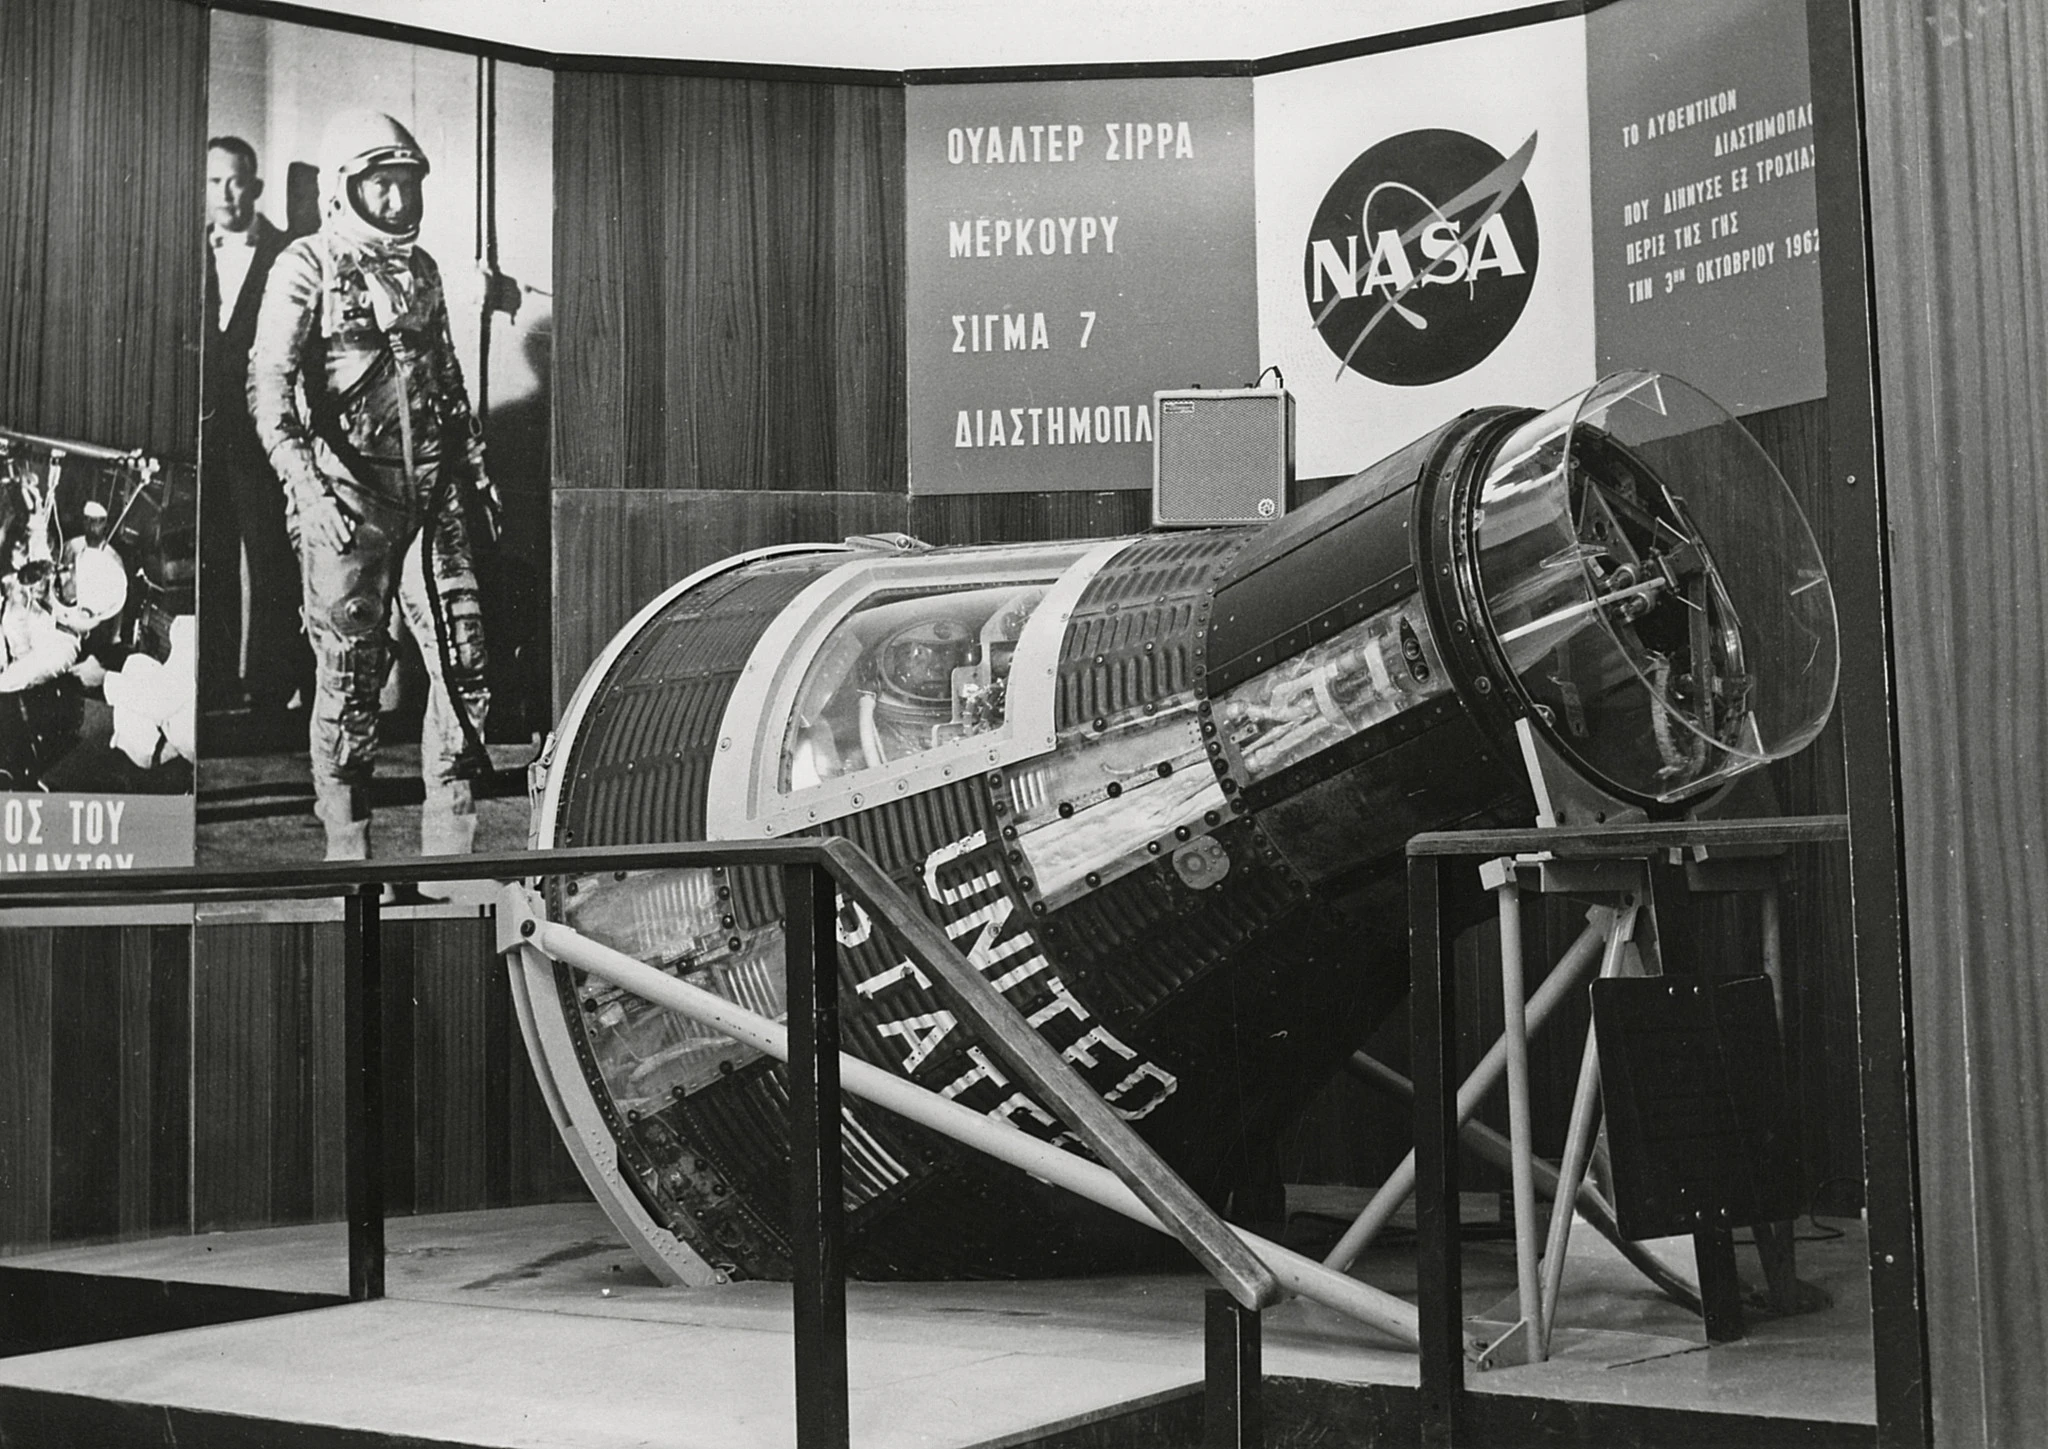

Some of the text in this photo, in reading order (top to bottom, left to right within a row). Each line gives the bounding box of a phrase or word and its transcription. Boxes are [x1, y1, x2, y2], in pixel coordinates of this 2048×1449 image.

[947, 121, 1195, 165] ΟΥΑΛΤΕΡ ΣΙΡΡΑ
[1622, 89, 1737, 148] ΤΟ ΑΥΘΕΝΤΙΚΟΝ
[1624, 198, 1650, 227] ΠΟΥ
[1663, 175, 1723, 215] ΔΙΗΝΥΣΕ
[1731, 166, 1749, 193] ΕΞ
[948, 215, 1119, 258] ΜΕΡΚΟΥΡΥ
[1309, 211, 1528, 305] NASA
[1626, 210, 1739, 266] ΠΕΡΙΞ ΤΗΣ ΓΗΣ
[1627, 277, 1653, 304] ΤΗΝ
[1696, 241, 1776, 285] ΟΚΤΩΒΡΙΟΥ
[1785, 227, 1820, 259] 1962
[951, 310, 1097, 353] ΣΙΓΜΑ 7
[4, 798, 125, 845] ΟΣ ΤΟΥ
[923, 829, 1178, 1121] UNITED
[835, 892, 1094, 1157] TATE
